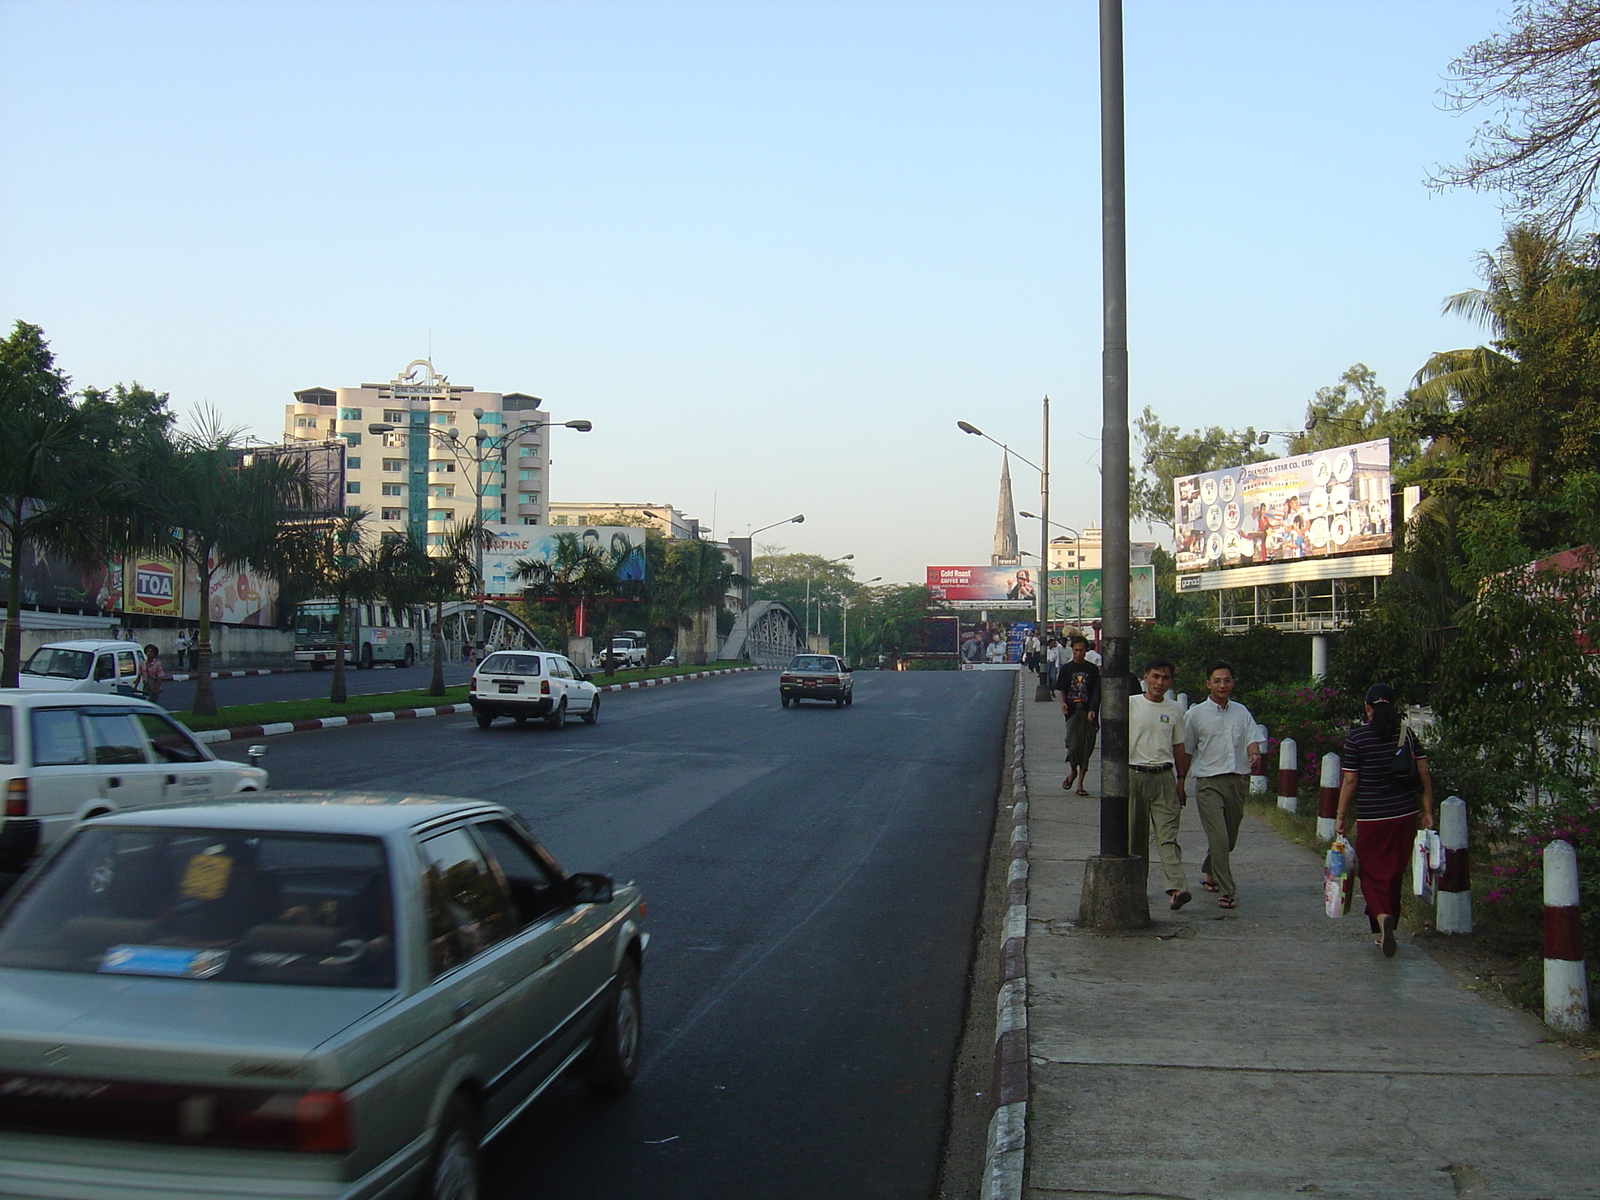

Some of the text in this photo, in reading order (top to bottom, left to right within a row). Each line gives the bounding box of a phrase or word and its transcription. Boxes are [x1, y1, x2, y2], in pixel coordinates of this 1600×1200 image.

[1274, 463, 1290, 473] STAR
[940, 570, 972, 578] Gold Roast
[138, 573, 173, 597] TOA
